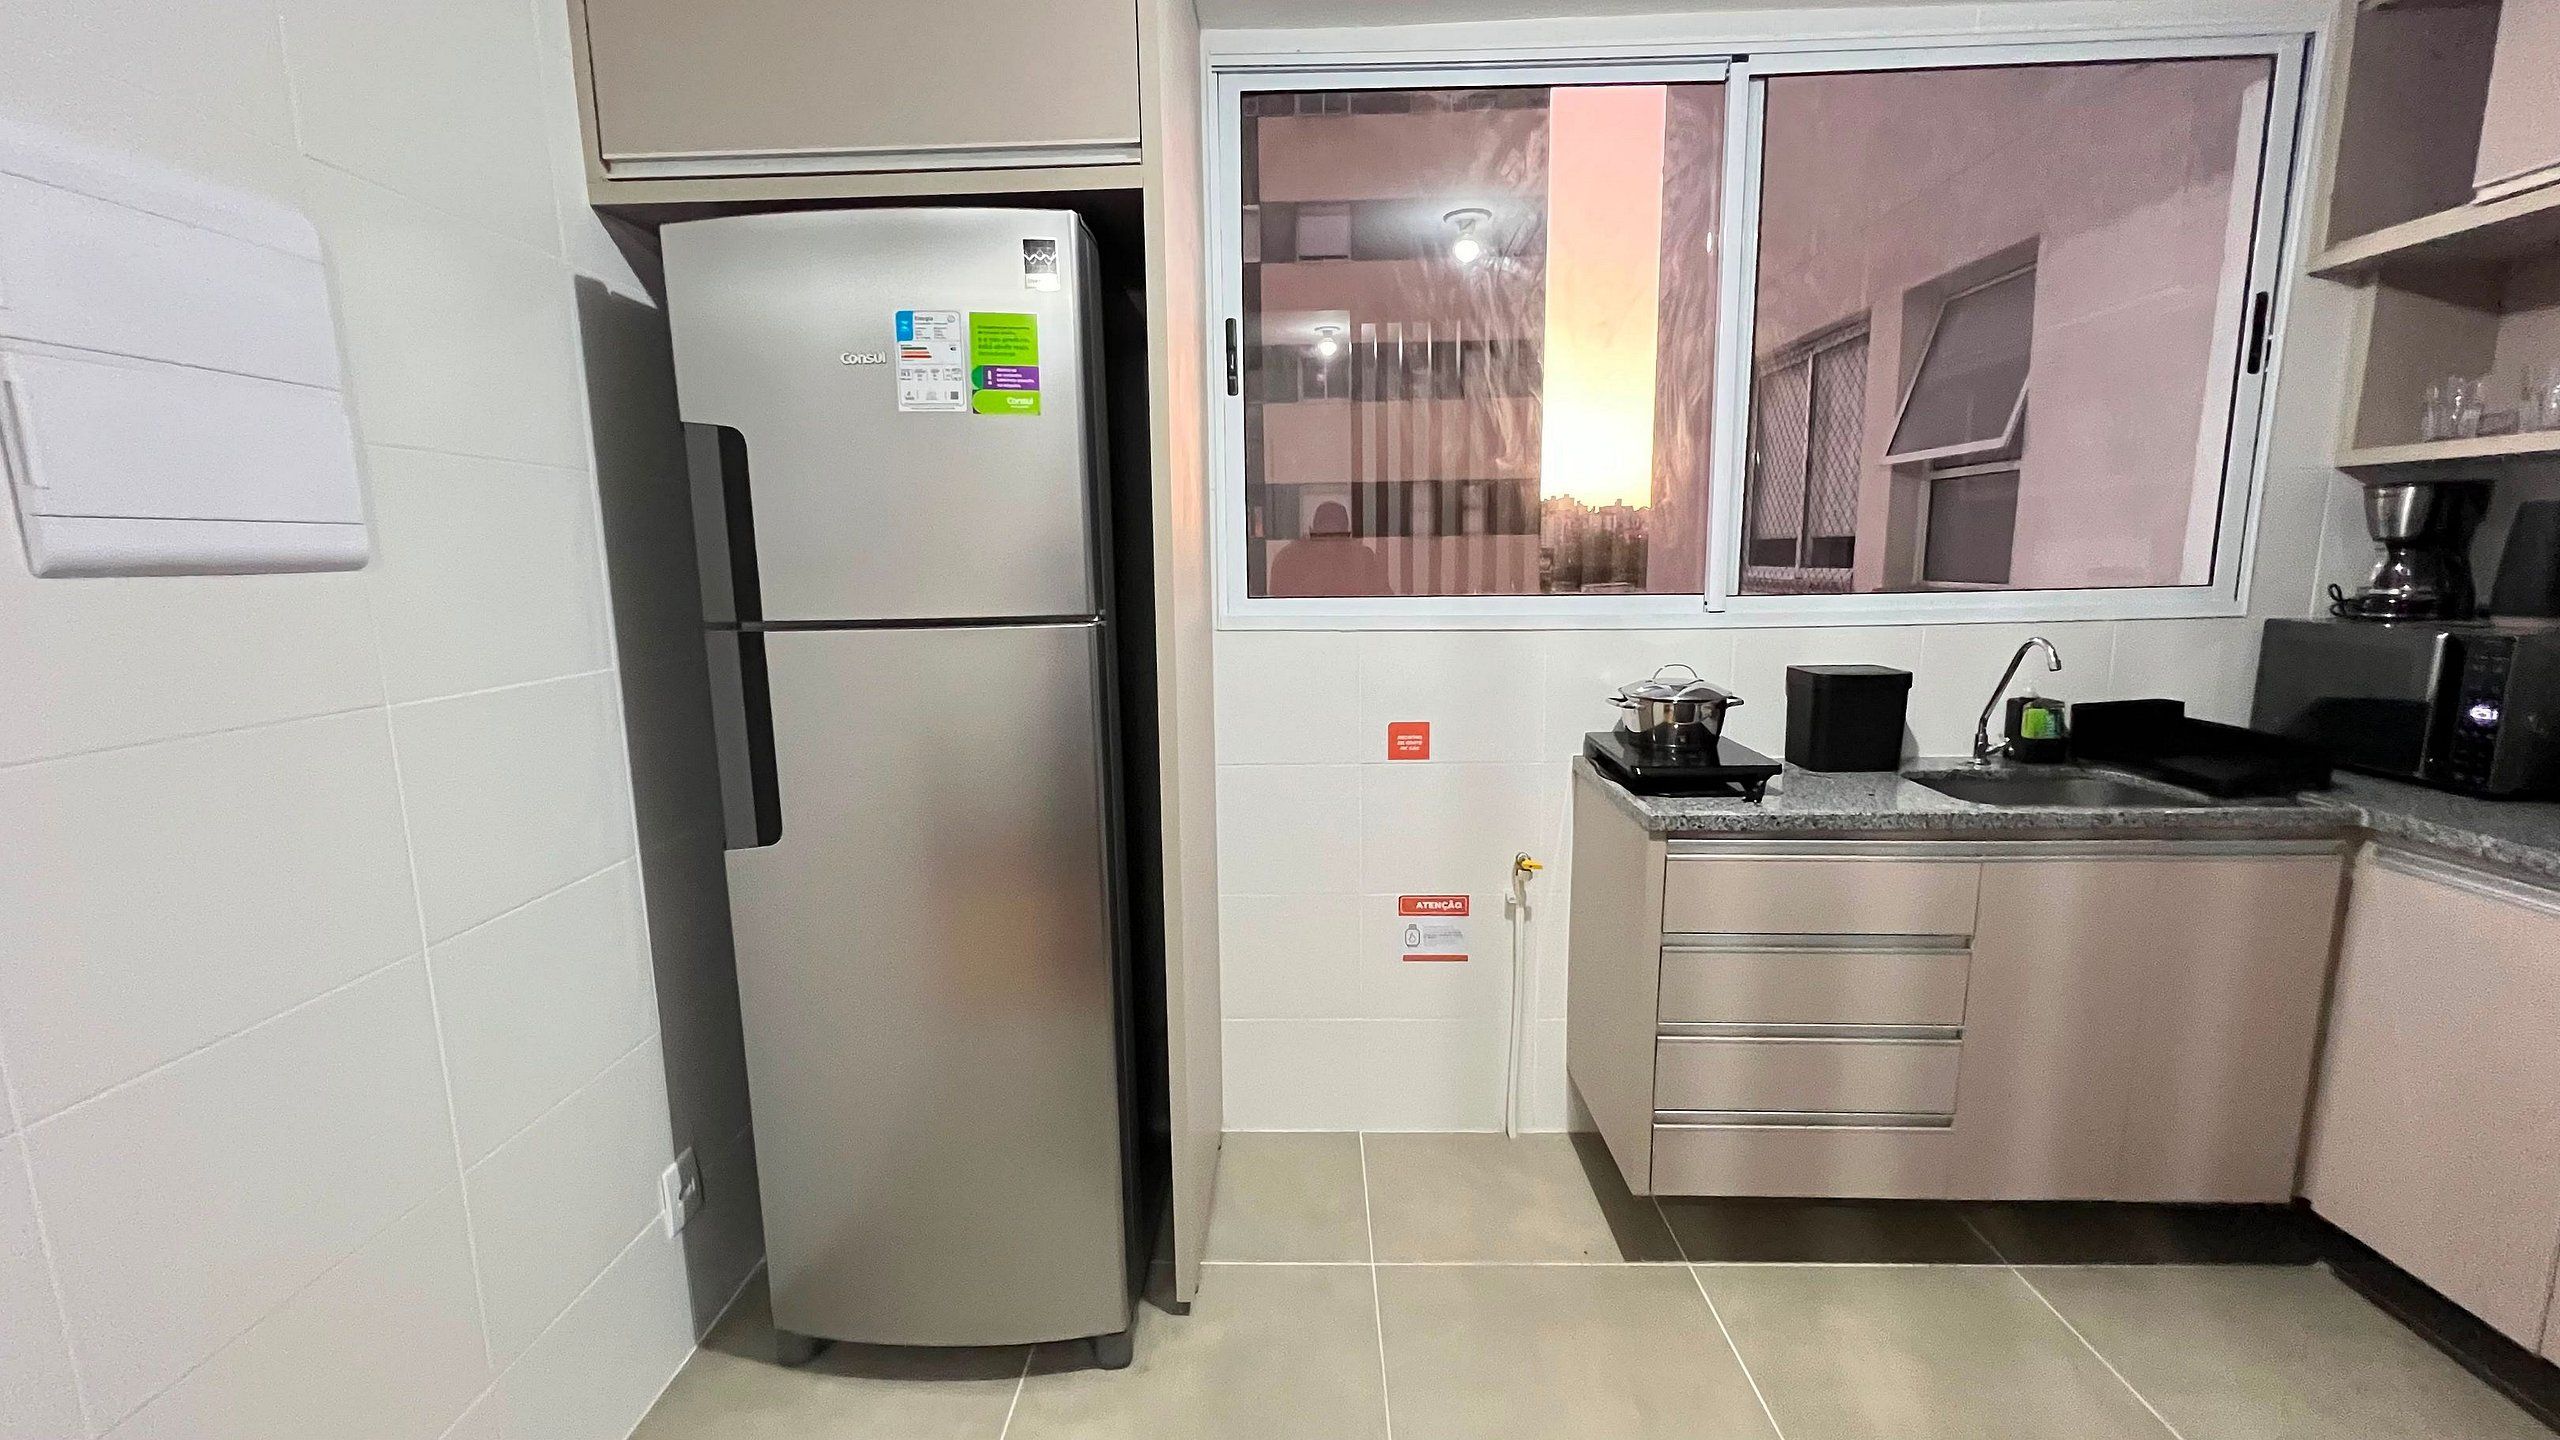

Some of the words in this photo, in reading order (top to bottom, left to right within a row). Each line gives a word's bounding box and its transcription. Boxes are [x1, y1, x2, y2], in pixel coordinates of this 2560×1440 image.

[840, 351, 887, 365] Consul
[1006, 397, 1034, 405] Consul
[1416, 900, 1463, 911] ATENÇÃO
